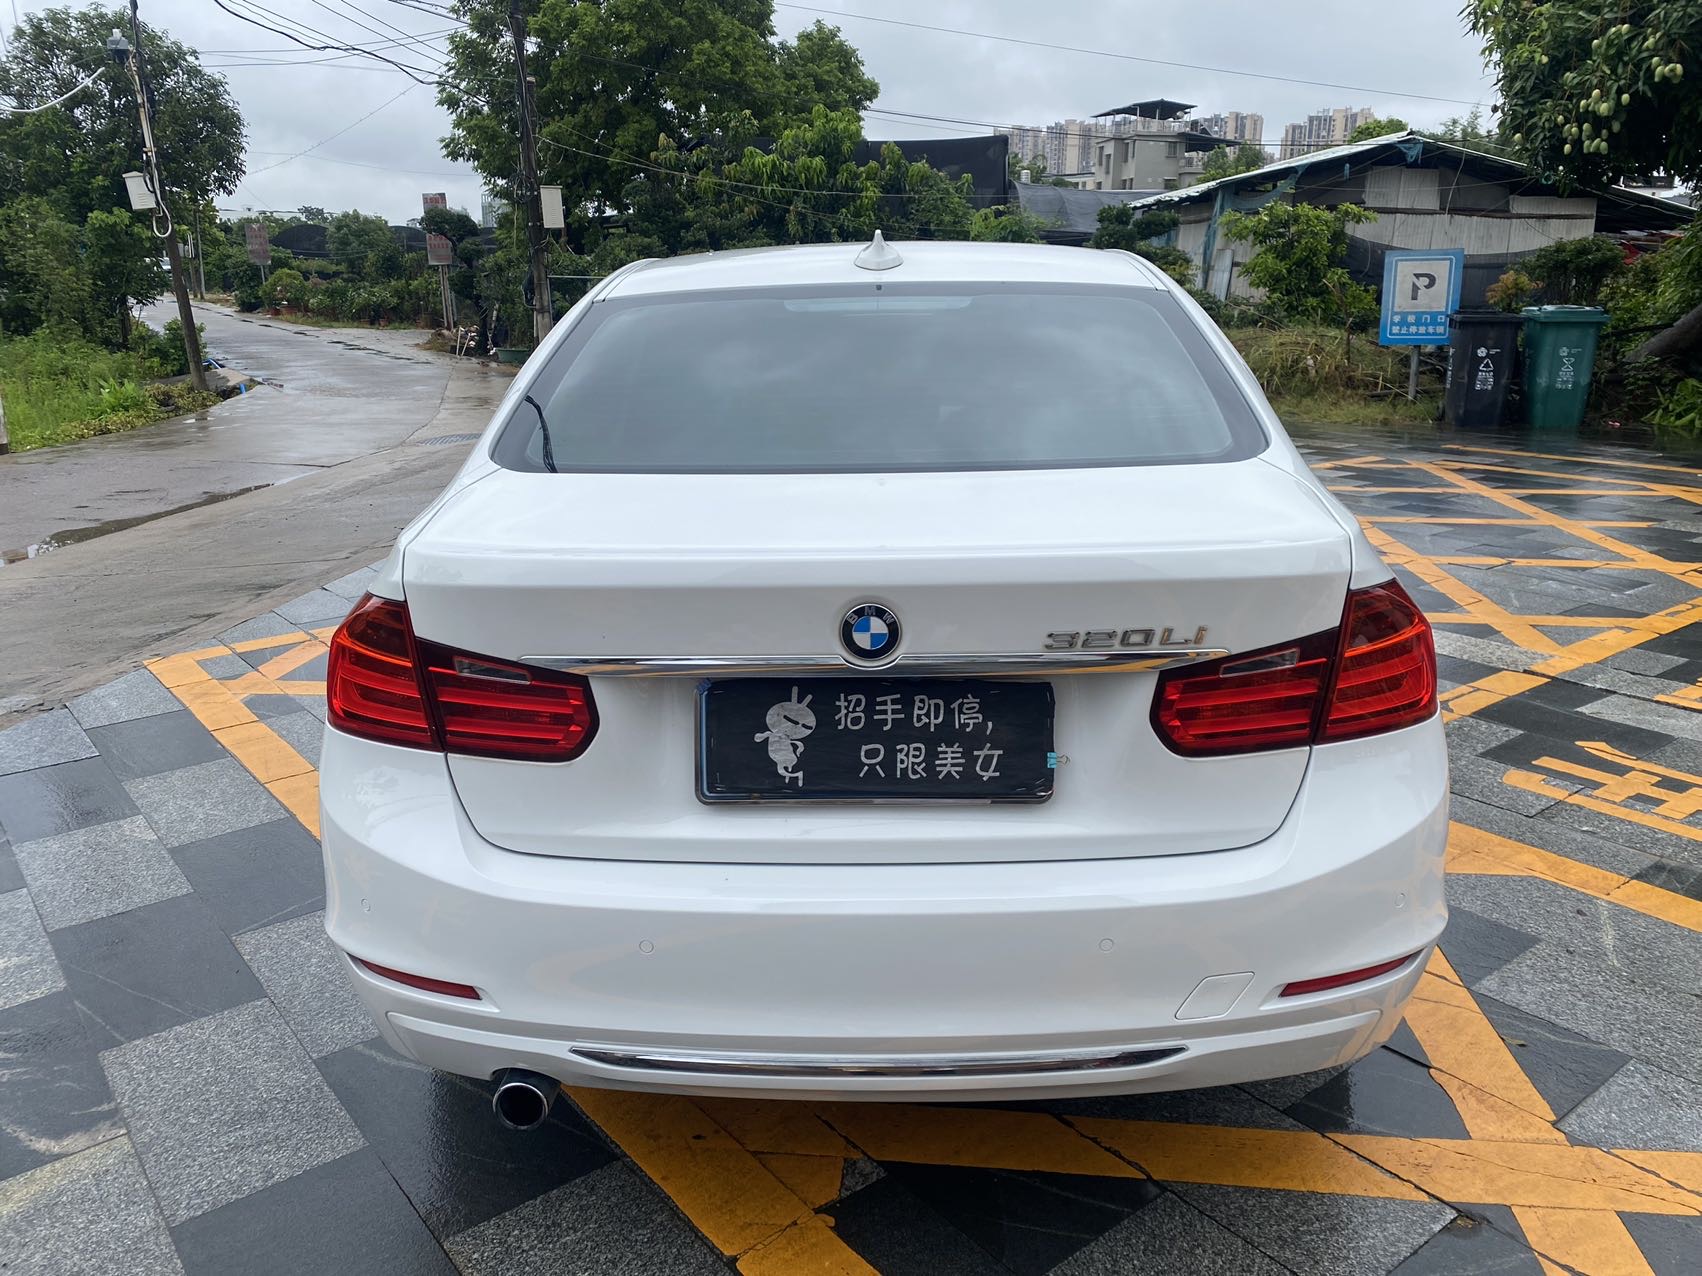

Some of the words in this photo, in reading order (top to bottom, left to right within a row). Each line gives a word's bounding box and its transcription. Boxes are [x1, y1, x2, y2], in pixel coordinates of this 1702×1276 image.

[1411, 273, 1437, 301] P
[846, 605, 895, 625] BMW
[858, 742, 1004, 782] 只限美女
